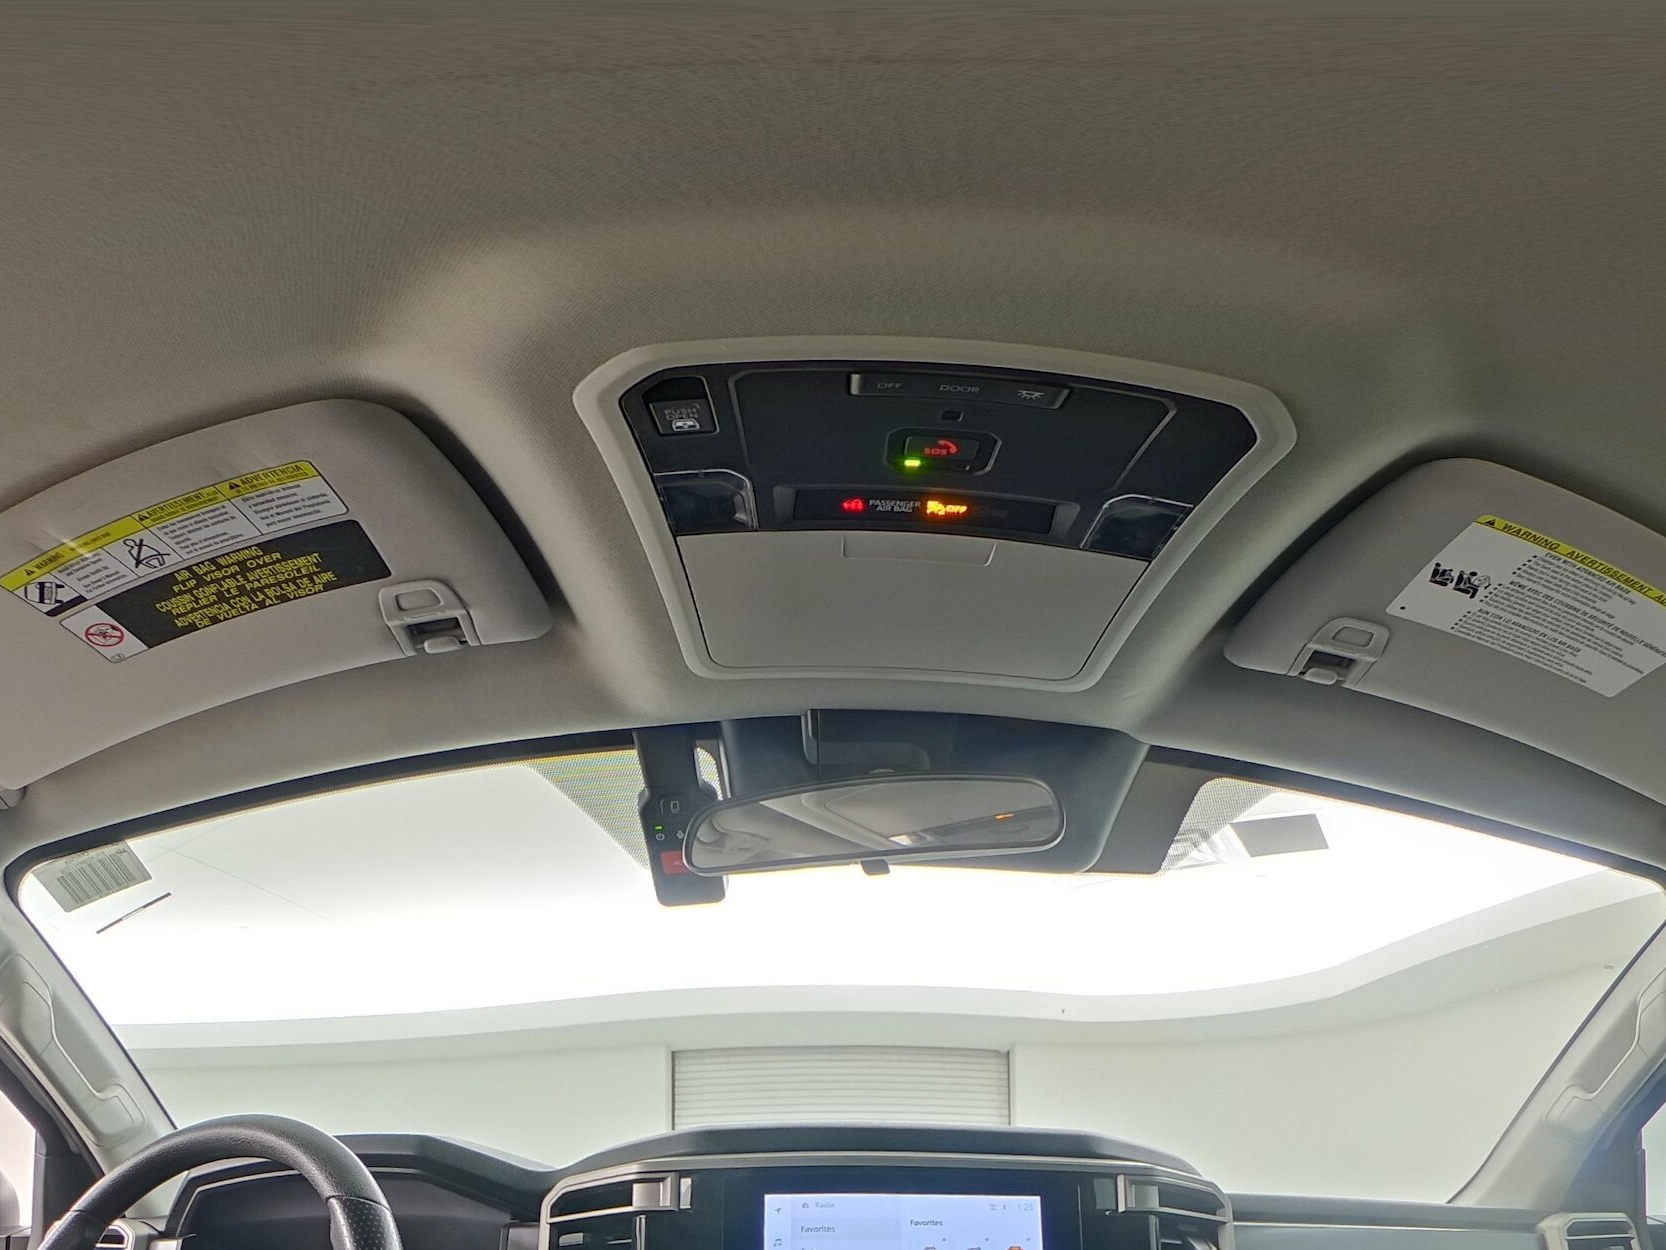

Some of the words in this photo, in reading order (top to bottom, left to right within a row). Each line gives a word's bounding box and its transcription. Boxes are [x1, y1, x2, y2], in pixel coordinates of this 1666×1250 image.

[940, 384, 980, 393] DOOR
[924, 447, 947, 455] SOS
[869, 500, 921, 508] PASSENGER
[893, 505, 913, 513] BAG
[945, 505, 968, 514] OFF
[34, 552, 65, 571] WARNING
[172, 579, 197, 594] FLIP
[203, 565, 240, 582] VISOR
[246, 552, 283, 568] OVER
[174, 570, 192, 582] AIR
[192, 561, 216, 576] BAG
[215, 546, 264, 567] WARNING
[1502, 523, 1561, 550] WARNING
[1566, 550, 1653, 594] AVERTISSEMENT
[155, 593, 194, 613] COUSSIN
[193, 576, 247, 600] GONFLABLE
[246, 552, 323, 582] AVERTISSEMENT
[171, 595, 218, 616] REPLIER
[223, 588, 240, 598] LE
[246, 565, 321, 591] PARESOLEIL
[173, 602, 232, 628] ADVERTENCIA
[230, 594, 252, 609] CON
[251, 589, 267, 602] LA
[264, 580, 298, 599] BOLSA
[297, 577, 313, 589] DE
[314, 571, 338, 585] AIRE
[195, 618, 213, 629] DE
[216, 603, 259, 621] VUELTA
[264, 597, 281, 606] AL
[286, 584, 325, 600] VISOR
